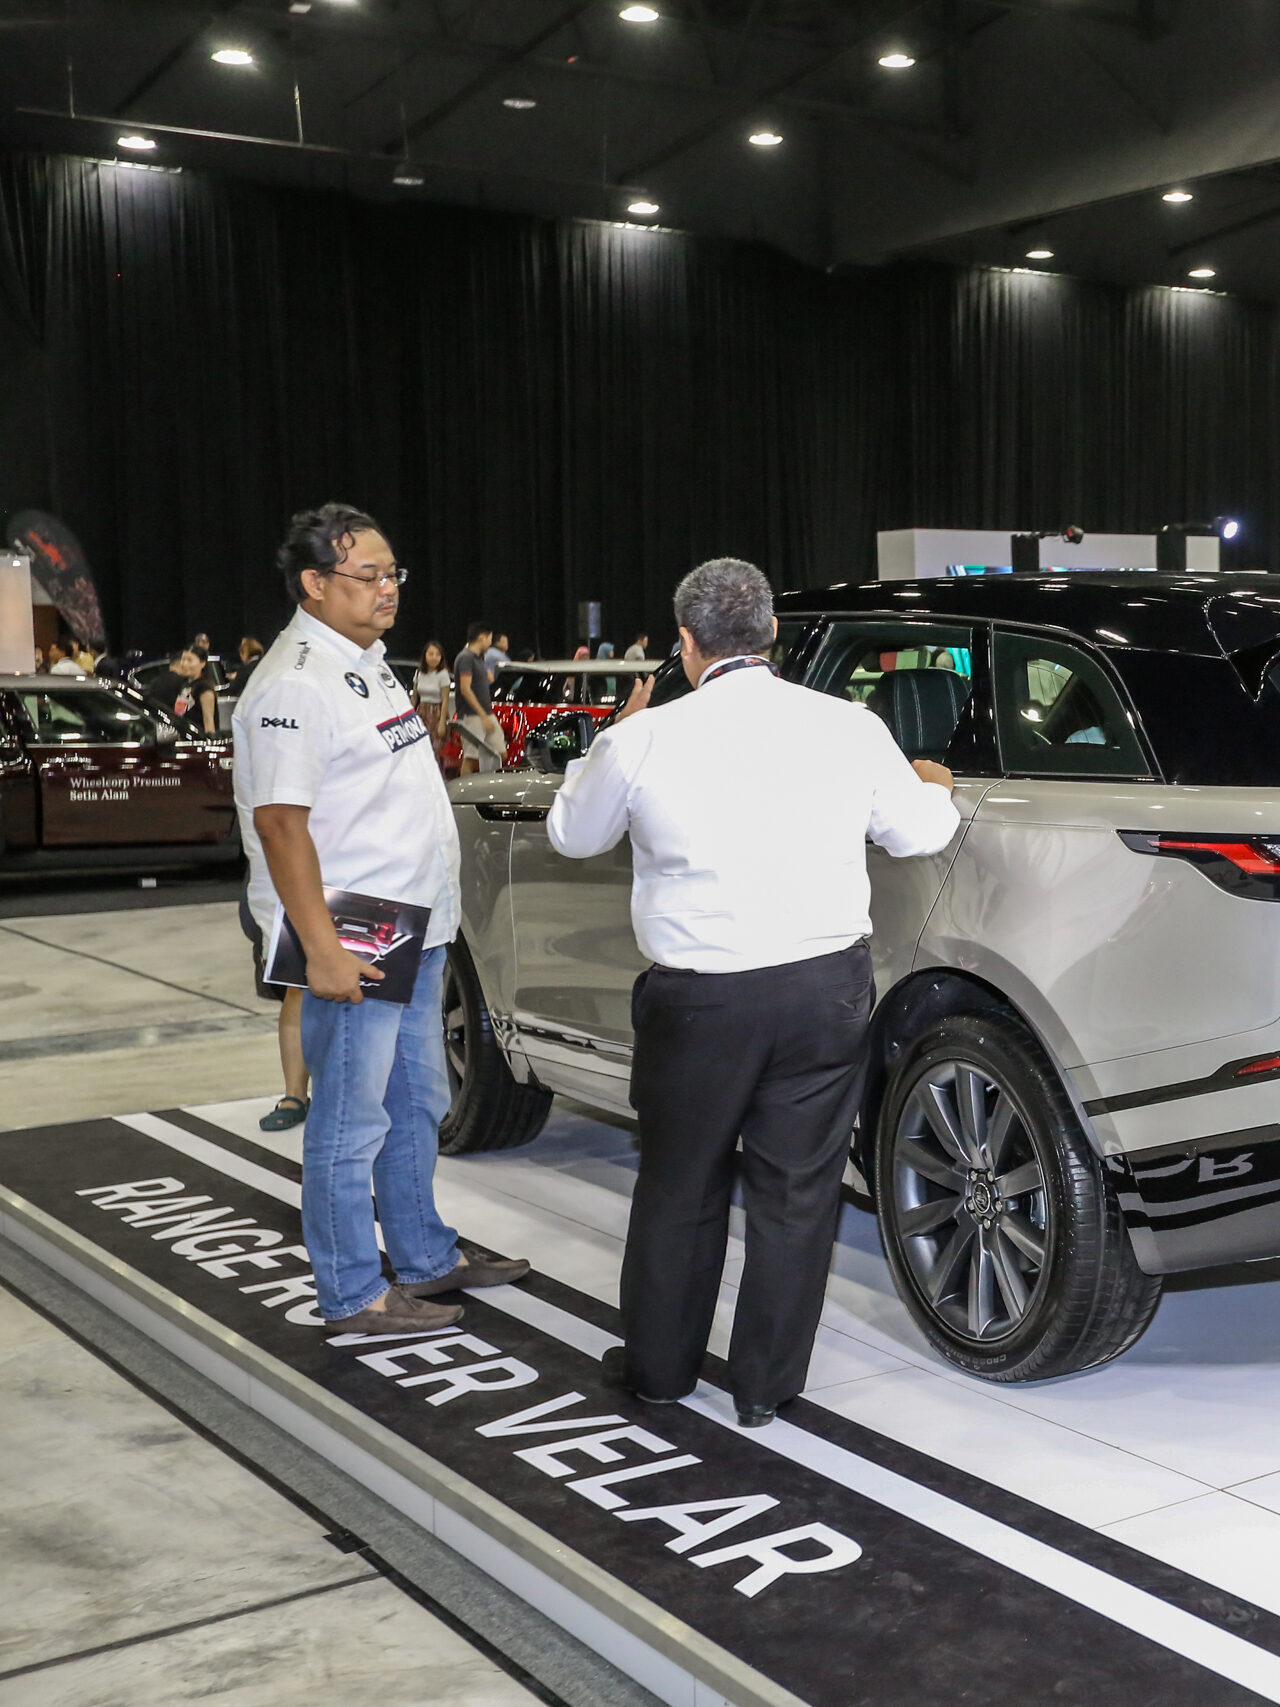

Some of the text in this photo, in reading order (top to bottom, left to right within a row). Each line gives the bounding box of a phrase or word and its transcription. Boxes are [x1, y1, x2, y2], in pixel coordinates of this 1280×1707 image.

[261, 717, 299, 729] DELL
[70, 775, 181, 789] Wheelcorp Premium
[101, 788, 129, 800] Alam
[75, 1176, 309, 1280] RANGE
[474, 1391, 863, 1599] VELAR
